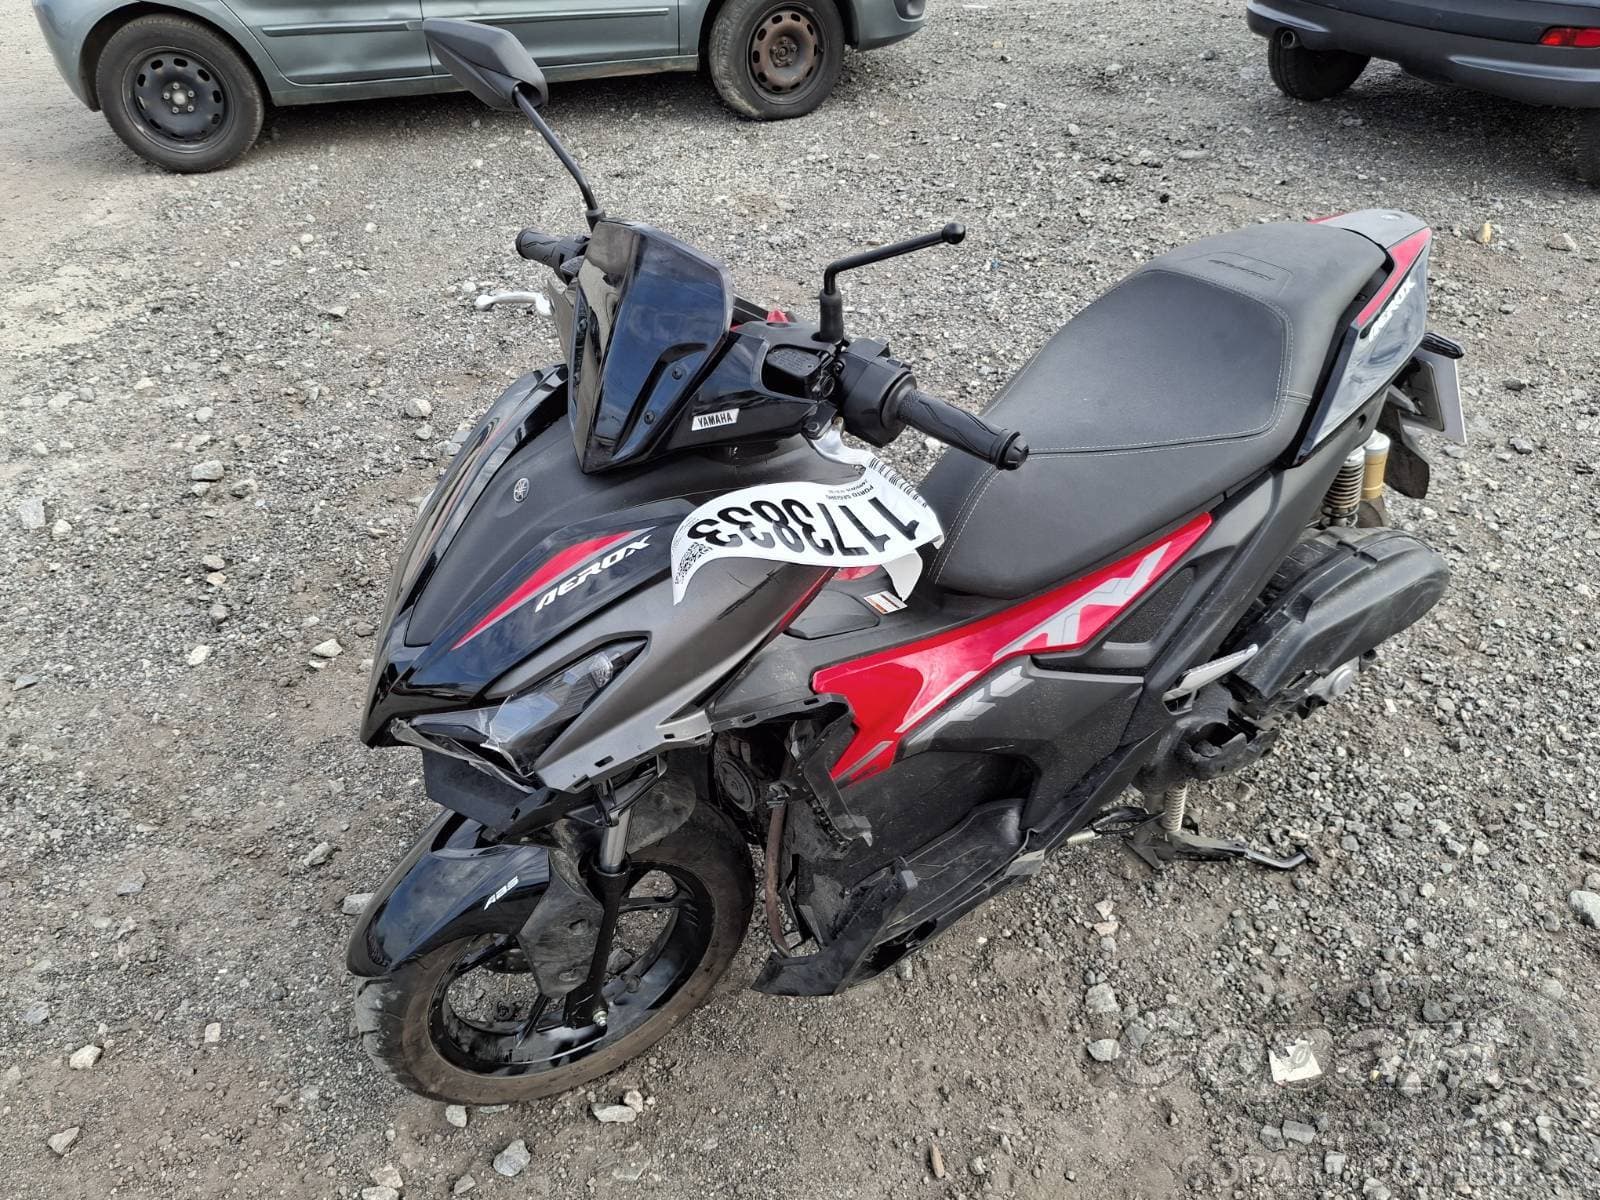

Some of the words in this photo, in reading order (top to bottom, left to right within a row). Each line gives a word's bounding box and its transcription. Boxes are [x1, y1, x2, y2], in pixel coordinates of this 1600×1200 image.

[697, 412, 734, 428] YAMAHA
[851, 484, 874, 497] PORTO
[687, 496, 920, 557] 1173833
[534, 534, 652, 614] AEROX
[483, 875, 520, 911] ABS
